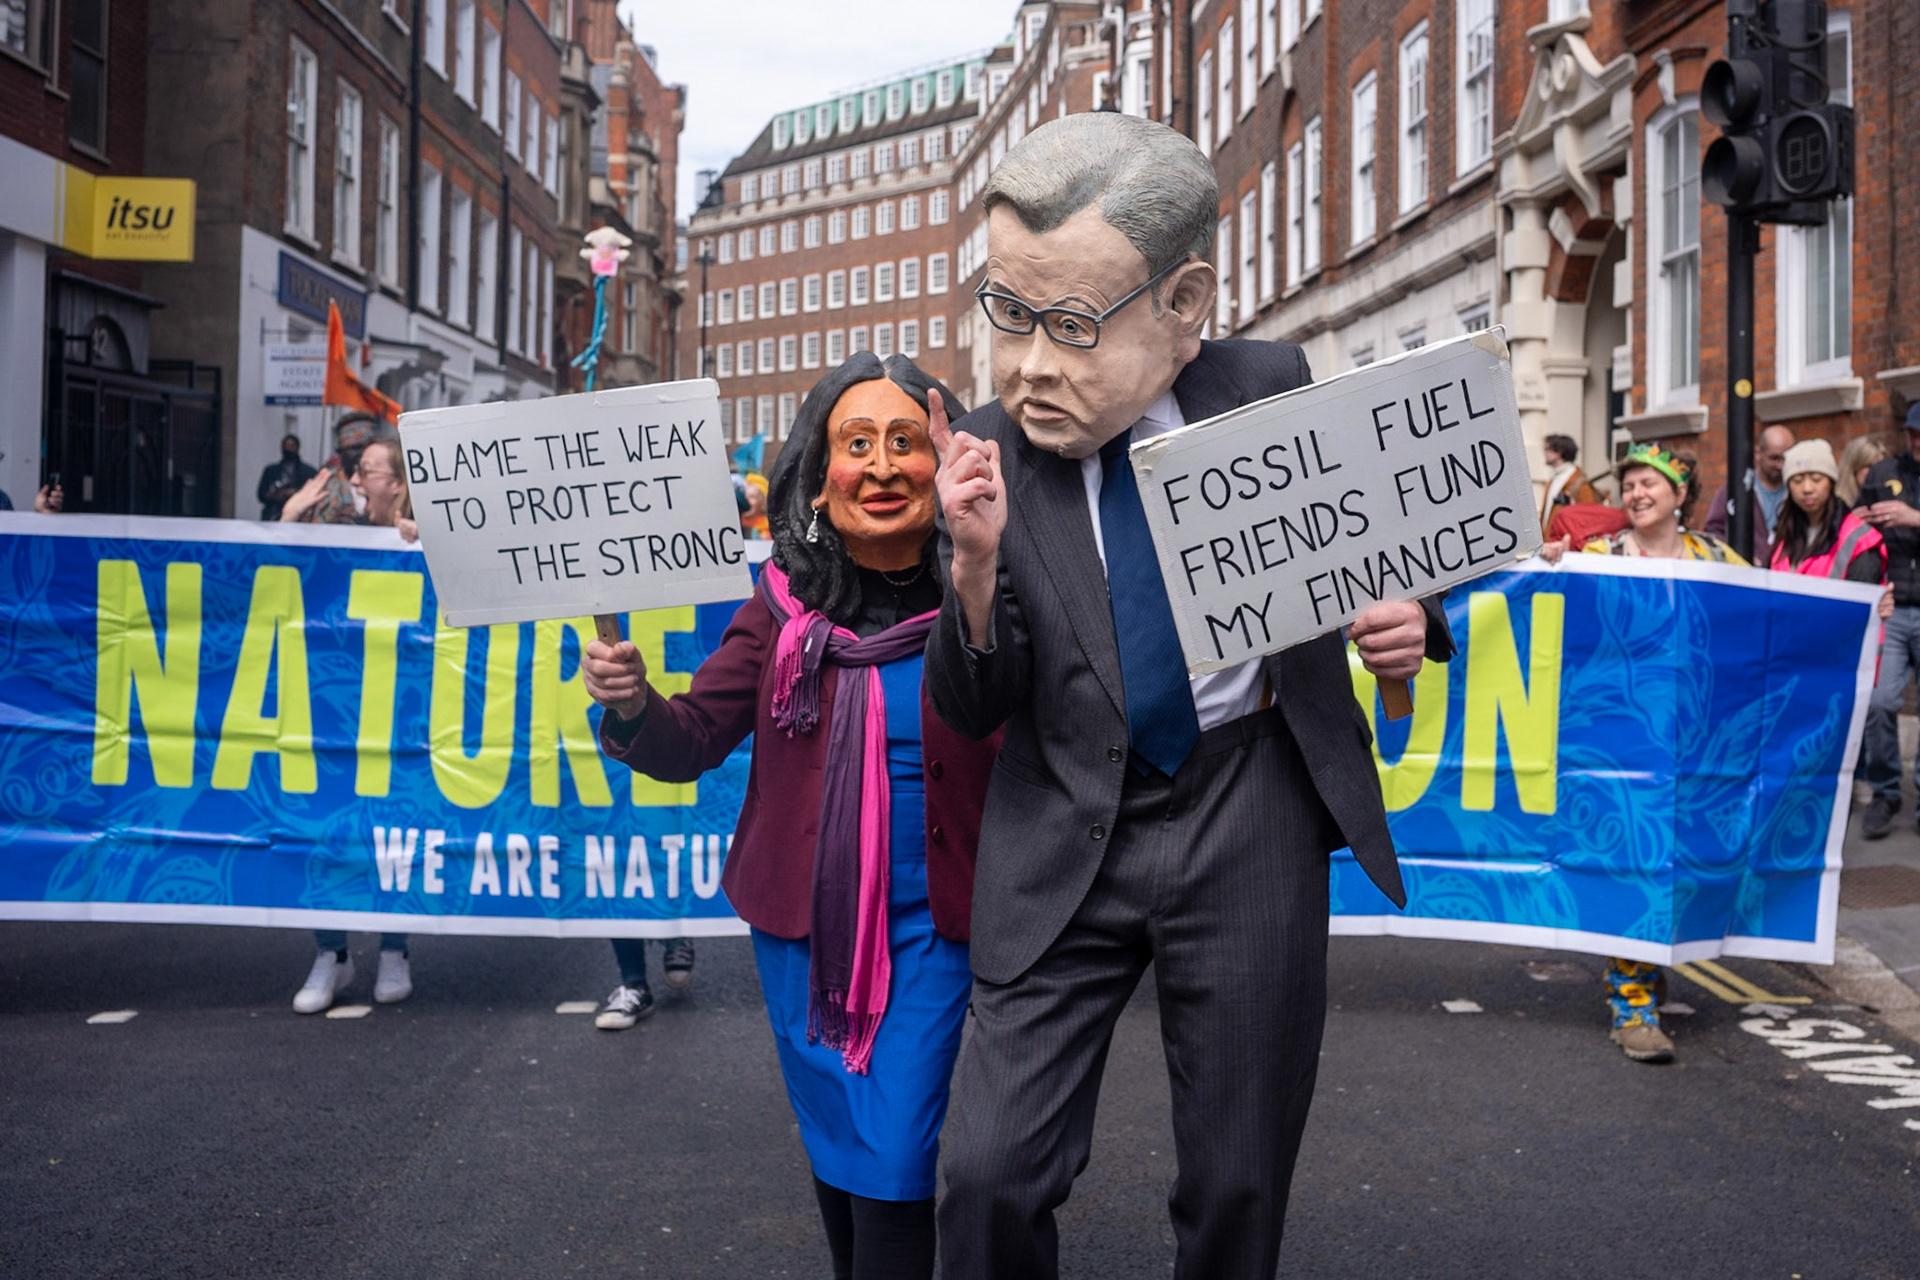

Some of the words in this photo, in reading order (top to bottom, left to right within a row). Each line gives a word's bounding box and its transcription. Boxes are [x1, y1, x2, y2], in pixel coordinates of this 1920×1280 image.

[106, 196, 175, 230] itsu
[407, 438, 528, 484] BLAME
[534, 431, 606, 471] THE
[617, 419, 708, 463] WEAK
[1162, 429, 1342, 525] FOSSIL
[1371, 378, 1495, 452] FUEL
[431, 496, 486, 532] TO
[505, 475, 683, 526] PROTECT
[1180, 488, 1370, 596] FRIENDS
[1393, 439, 1506, 517] FUND
[497, 542, 587, 585] THE
[598, 526, 745, 577] STRONG
[1204, 591, 1274, 660] MY
[1305, 506, 1519, 626] FINANCES
[373, 826, 447, 895] WE
[469, 832, 561, 899] ARE
[584, 833, 736, 900] NATU
